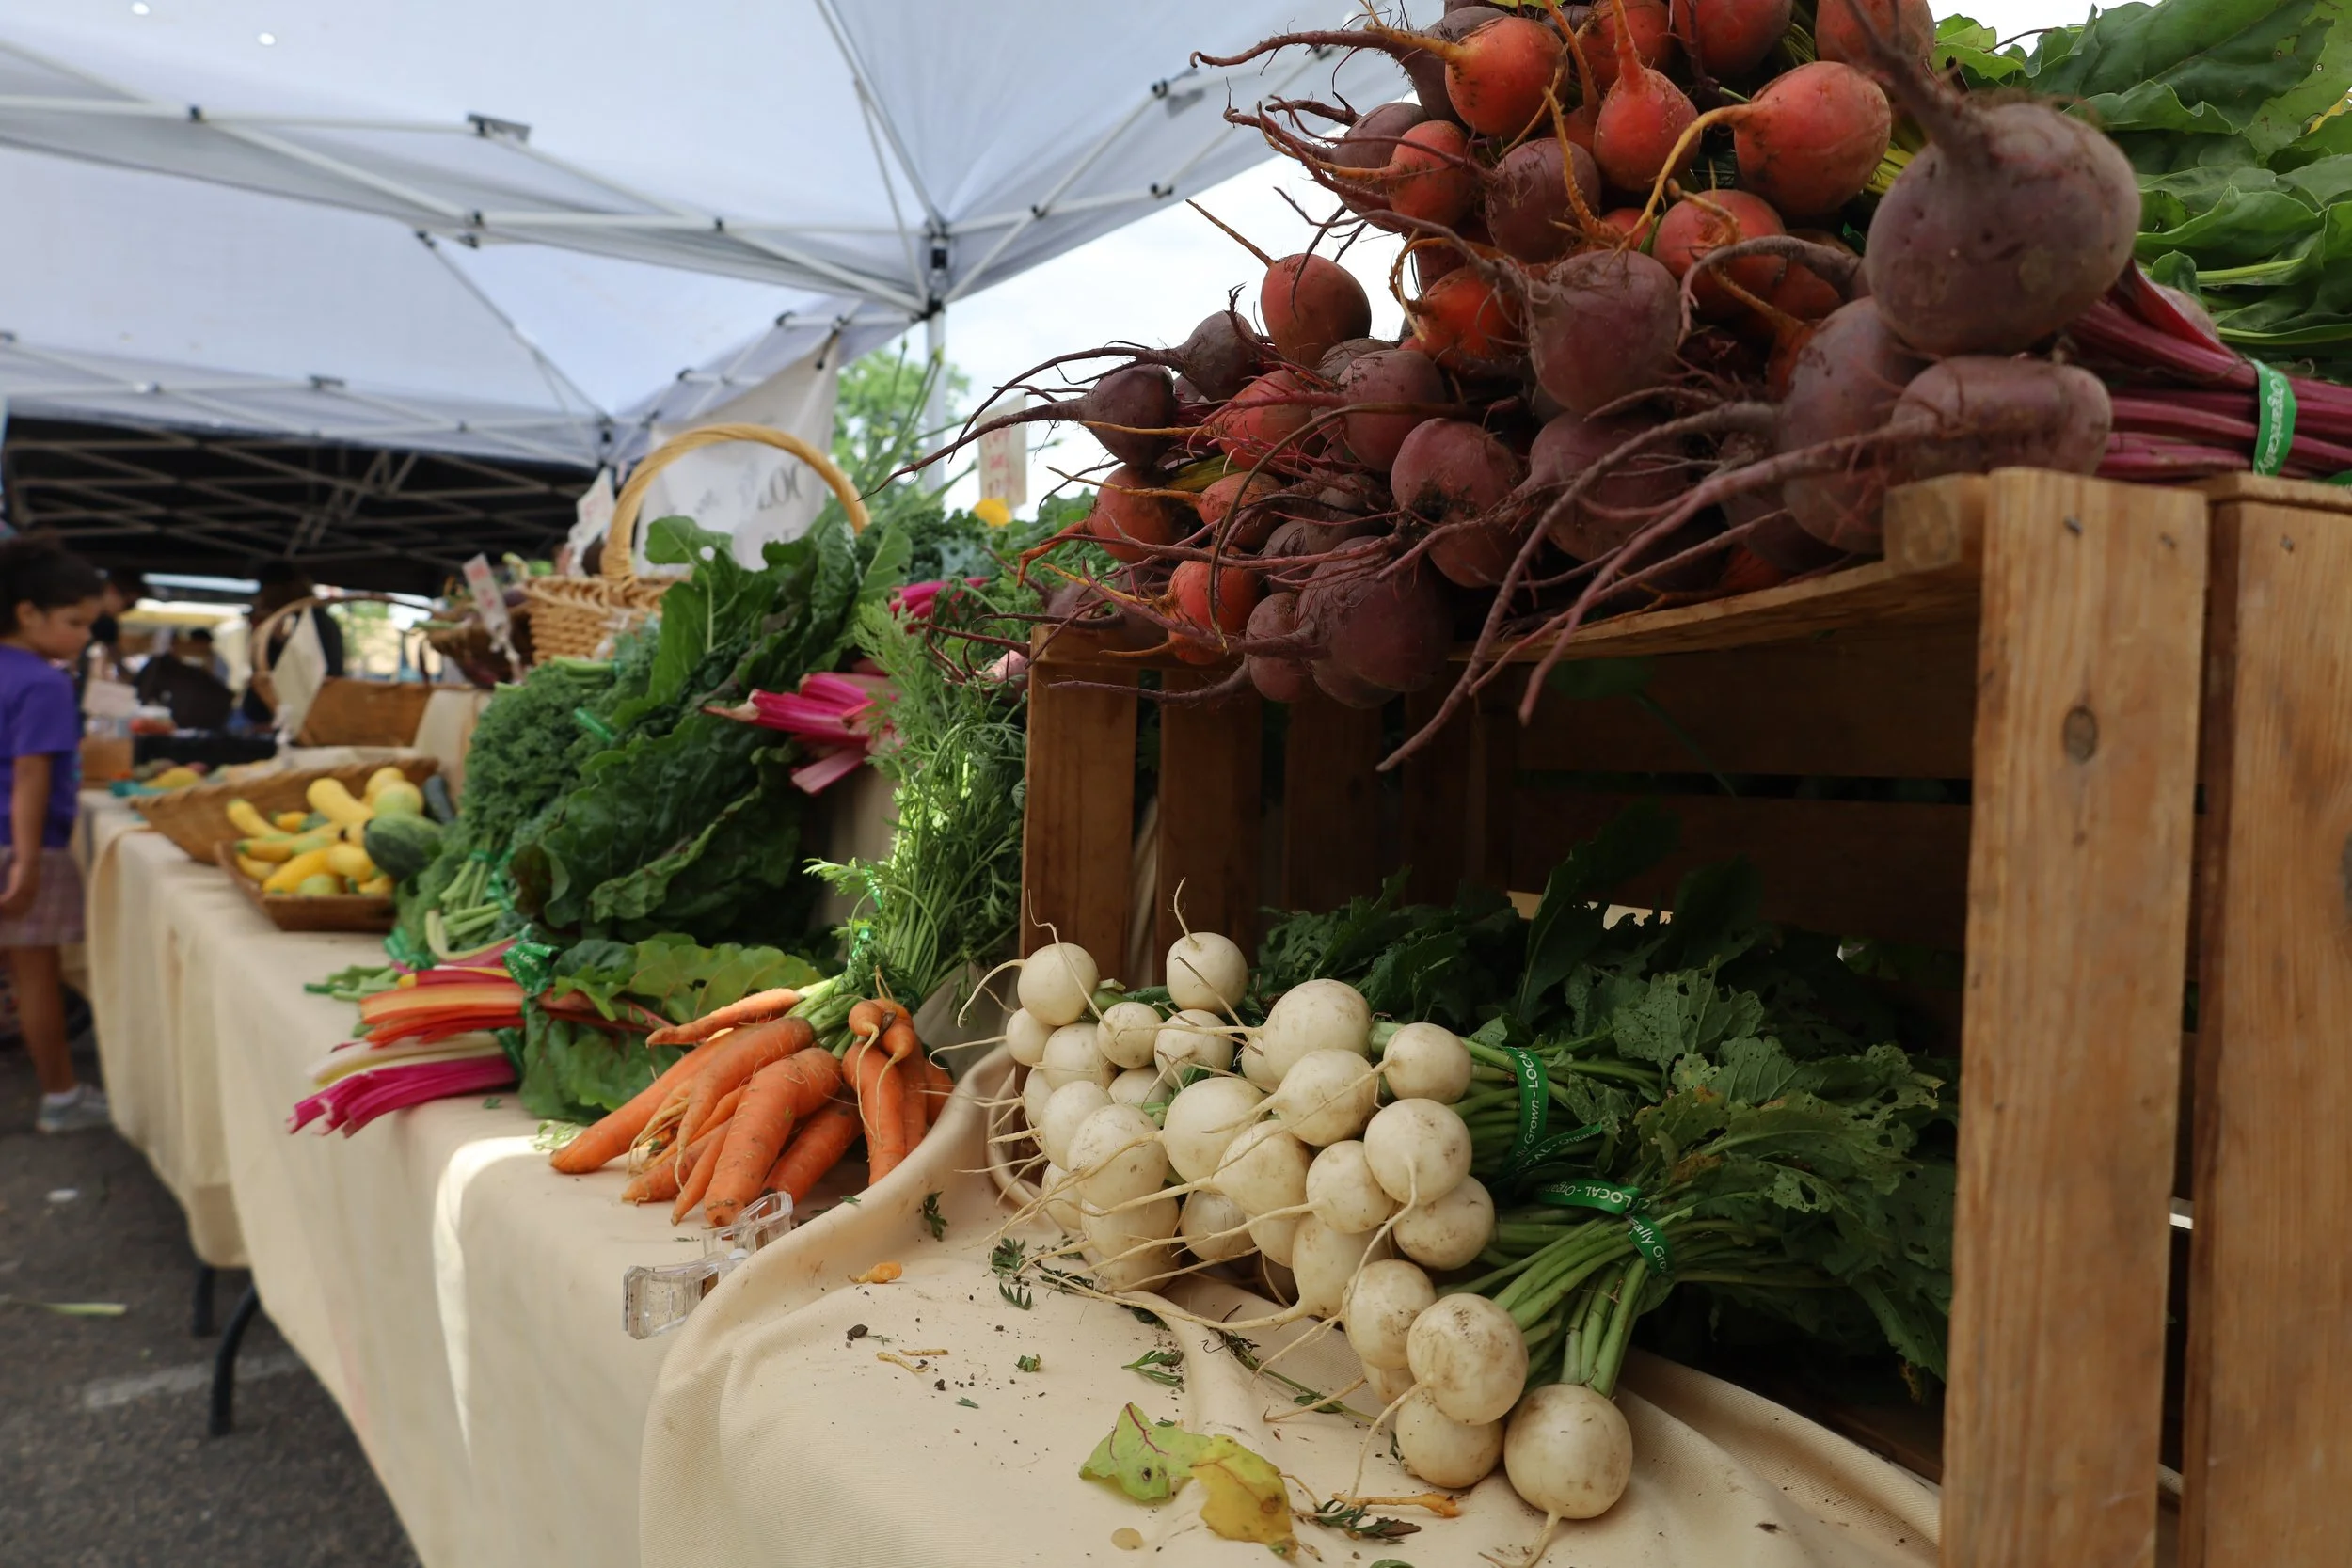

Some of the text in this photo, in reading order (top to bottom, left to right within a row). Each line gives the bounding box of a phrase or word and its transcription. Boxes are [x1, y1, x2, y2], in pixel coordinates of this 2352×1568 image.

[1524, 1099, 1539, 1144] Grown
[1585, 1186, 1632, 1208] LOCAL
[1653, 1245, 1667, 1272] Gro
